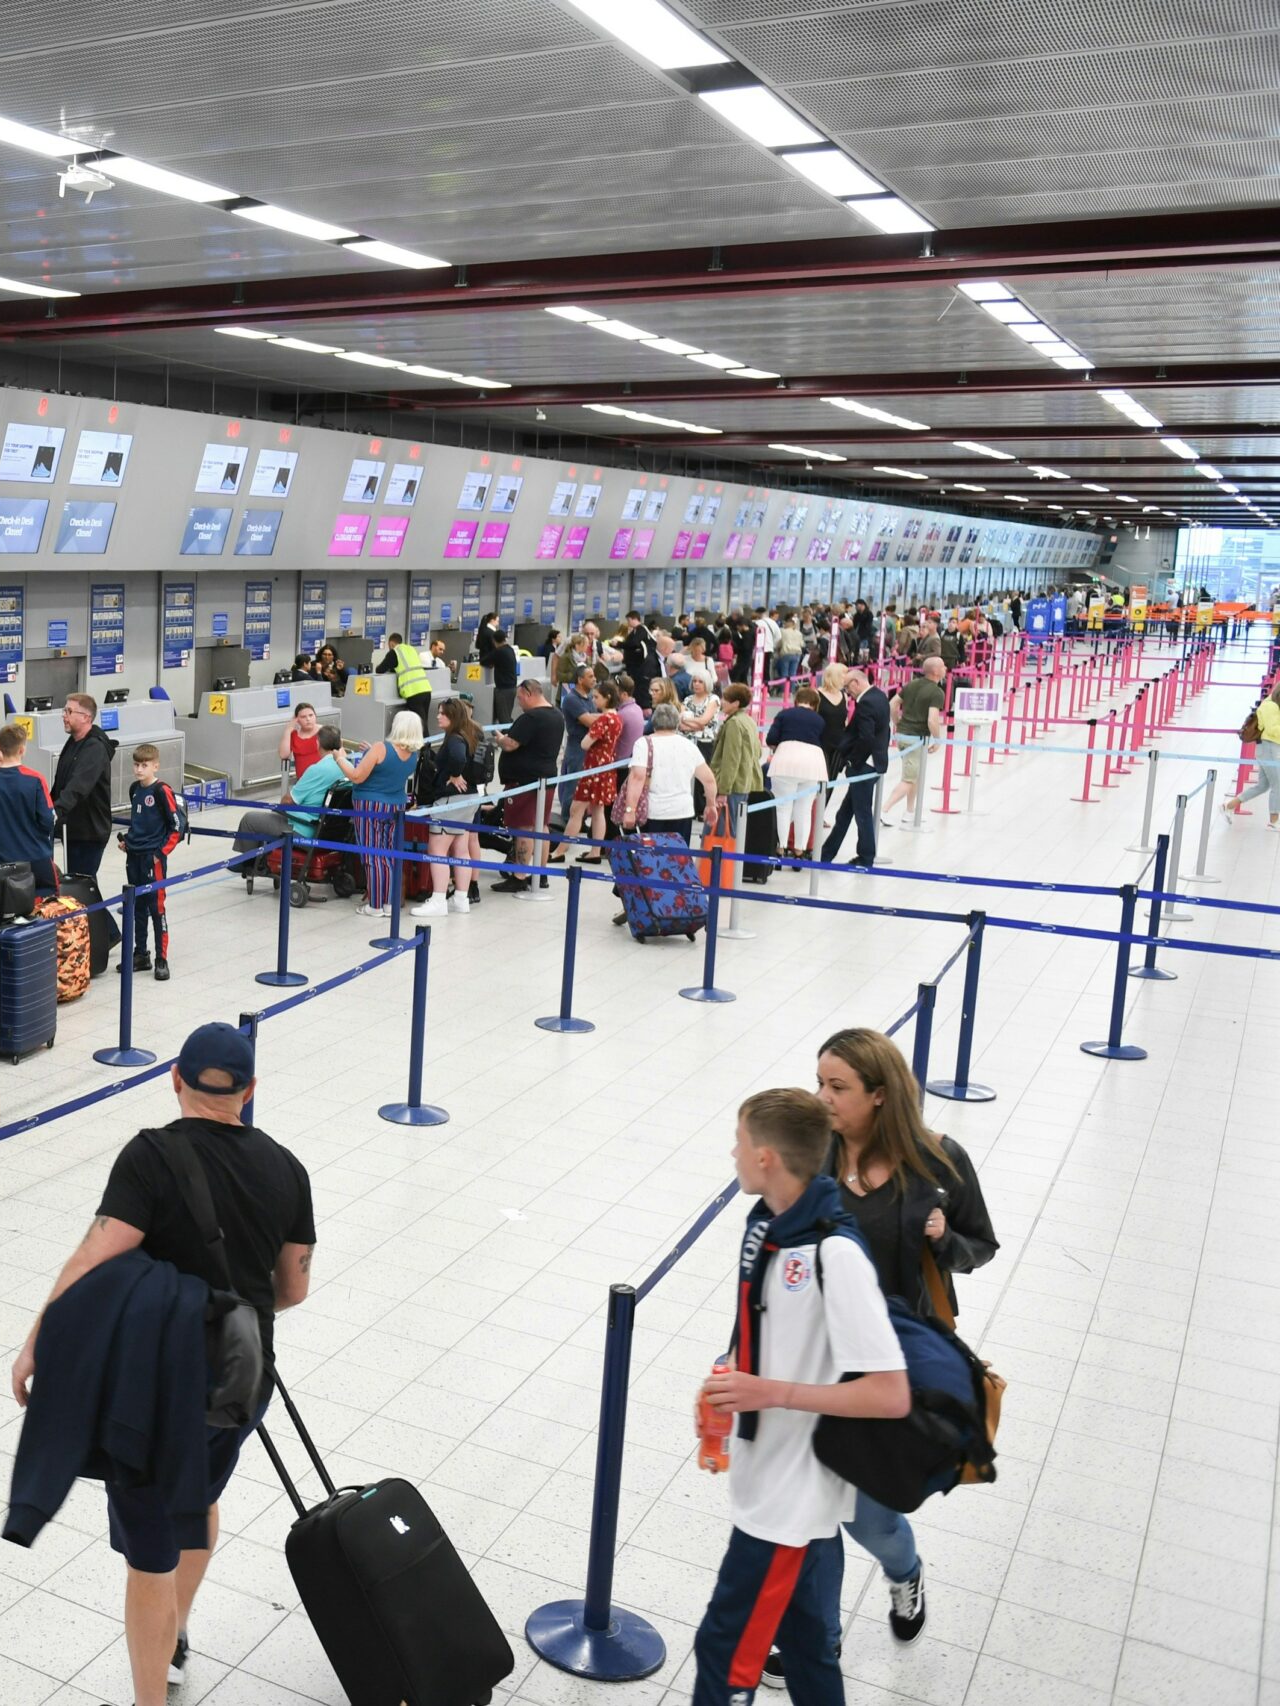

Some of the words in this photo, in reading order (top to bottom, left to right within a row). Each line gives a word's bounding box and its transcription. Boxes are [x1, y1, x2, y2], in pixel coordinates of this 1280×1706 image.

[21, 516, 34, 525] Desk
[5, 527, 23, 536] Closed
[423, 854, 447, 864] Departure
